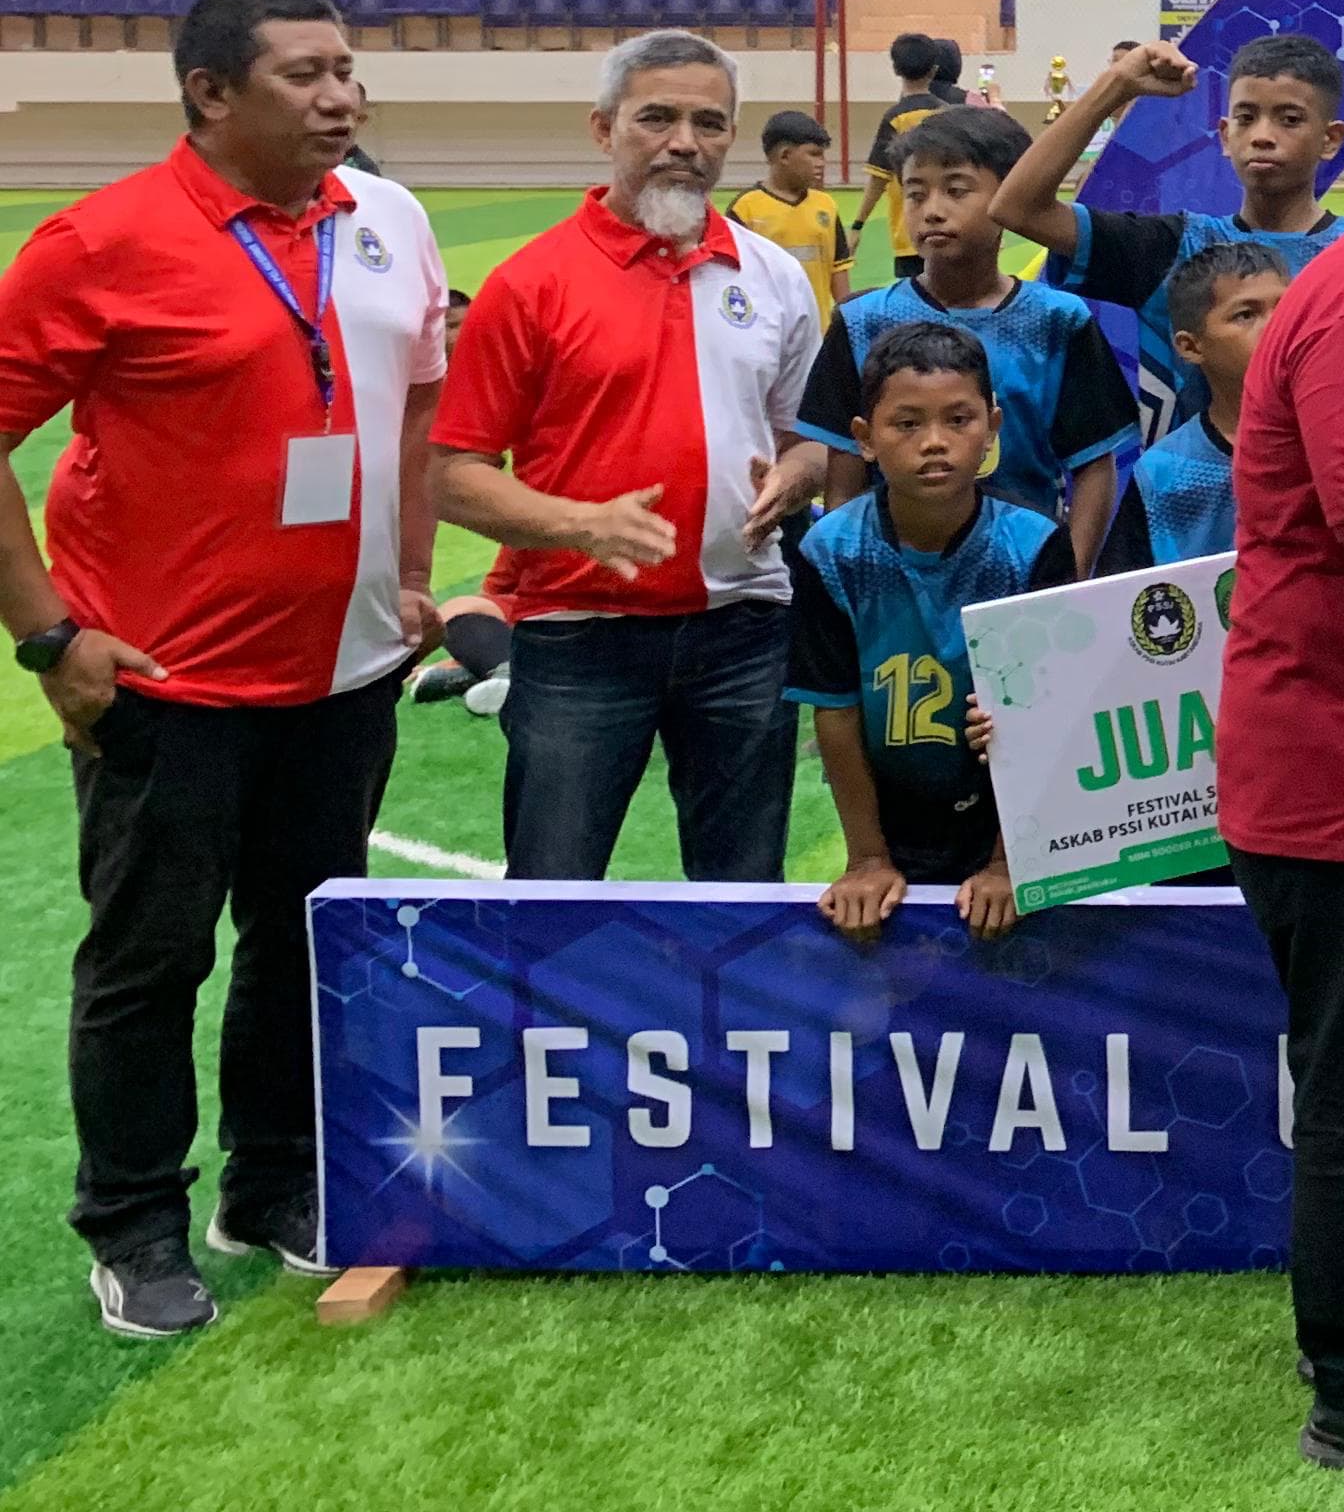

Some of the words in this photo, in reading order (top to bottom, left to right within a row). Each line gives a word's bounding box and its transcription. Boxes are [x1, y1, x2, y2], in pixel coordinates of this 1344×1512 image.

[873, 653, 957, 746] 12
[1076, 690, 1216, 791] JUA
[1049, 829, 1104, 853] ASKAB
[1108, 820, 1143, 838] PSSI
[1148, 807, 1199, 830] KUTAI
[1127, 789, 1203, 818] FESTIVAL
[415, 1025, 1169, 1153] FESTIVAL
